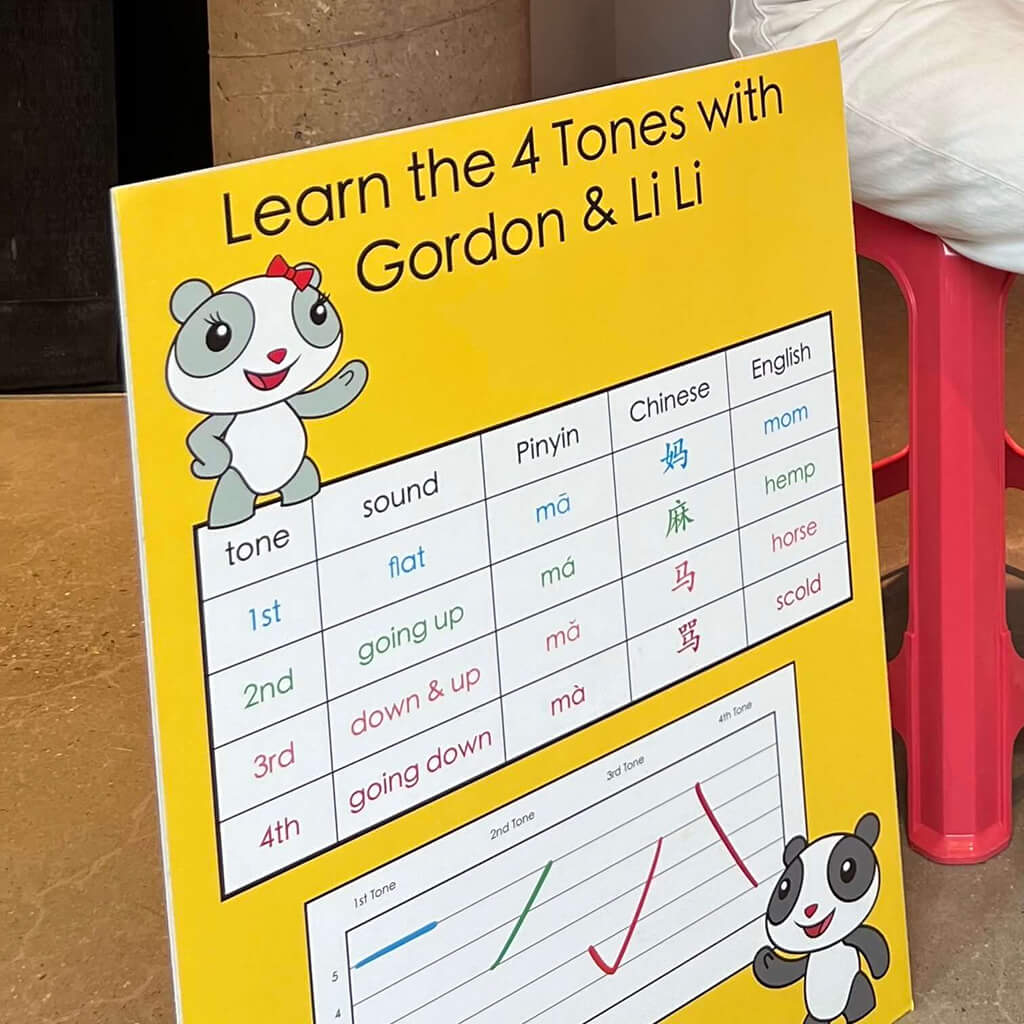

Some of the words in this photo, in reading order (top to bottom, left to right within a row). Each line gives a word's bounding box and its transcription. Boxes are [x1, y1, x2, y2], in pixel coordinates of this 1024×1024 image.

[223, 170, 391, 245] Learn
[406, 148, 496, 202] the
[512, 125, 541, 175] 4
[551, 102, 686, 164] Tones
[697, 75, 783, 133] with
[356, 200, 566, 292] Gordon
[583, 185, 618, 229] &
[630, 173, 663, 222] Li
[674, 160, 704, 210] Li
[751, 343, 811, 380] English
[628, 381, 710, 422] Chinese
[763, 404, 809, 434] mom
[516, 425, 580, 465] Pinyin
[660, 438, 688, 473] 妈
[361, 471, 439, 519] sound
[763, 460, 816, 496] hemp
[534, 493, 571, 523] mā
[665, 500, 692, 538] 麻
[225, 526, 290, 566] tone
[770, 518, 818, 552] horse
[388, 546, 426, 578] flat
[541, 557, 576, 587] má
[671, 560, 696, 593] 马
[775, 574, 821, 611] scold
[247, 600, 282, 631] 1st
[358, 615, 429, 665] going
[433, 603, 464, 639] up
[676, 619, 701, 653] 骂
[243, 668, 295, 711] 2nd
[350, 691, 420, 736] down
[427, 679, 445, 701] &
[449, 666, 482, 701] up
[550, 685, 586, 716] mà
[718, 711, 733, 723] 4th
[733, 701, 753, 719] Tone
[253, 741, 295, 779] 3rd
[348, 762, 419, 814] going
[426, 726, 493, 771] down
[606, 767, 622, 782] 3rd
[622, 755, 645, 776] Tone
[259, 817, 300, 850] 4th
[489, 824, 509, 841] 2nd
[511, 810, 536, 831] Tone
[352, 891, 368, 910] 1st
[369, 880, 397, 902] Tone
[331, 970, 338, 982] 5
